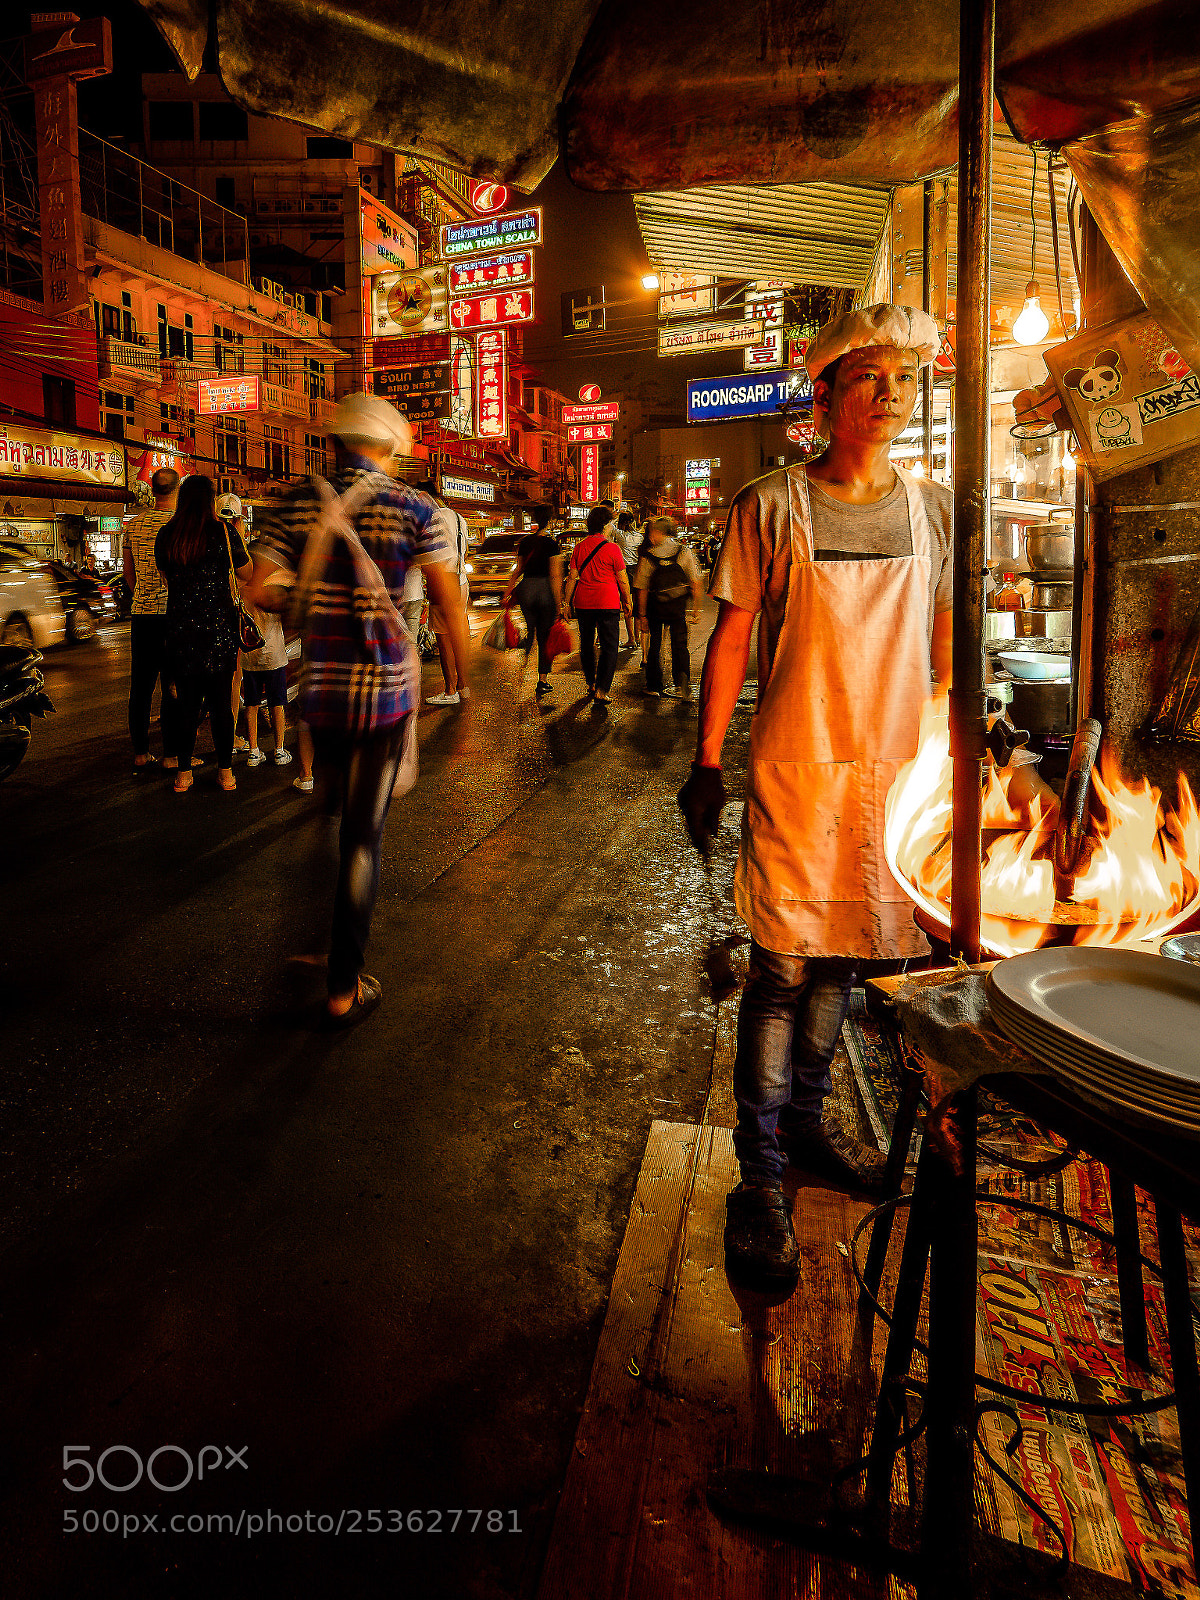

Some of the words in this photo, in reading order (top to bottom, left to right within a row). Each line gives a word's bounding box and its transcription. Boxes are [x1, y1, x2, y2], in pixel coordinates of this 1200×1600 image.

[445, 240, 474, 254] CHINA
[475, 235, 503, 249] TOWN
[505, 230, 537, 244] SCALA
[453, 292, 526, 327] 中國城
[380, 370, 412, 385] รังนก
[387, 384, 410, 393] BIRD
[412, 380, 437, 391] NEST
[691, 383, 774, 409] ROONGSARP
[570, 426, 609, 440] 中國城
[66, 446, 107, 473] 海外天
[979, 1272, 1058, 1363] 110
